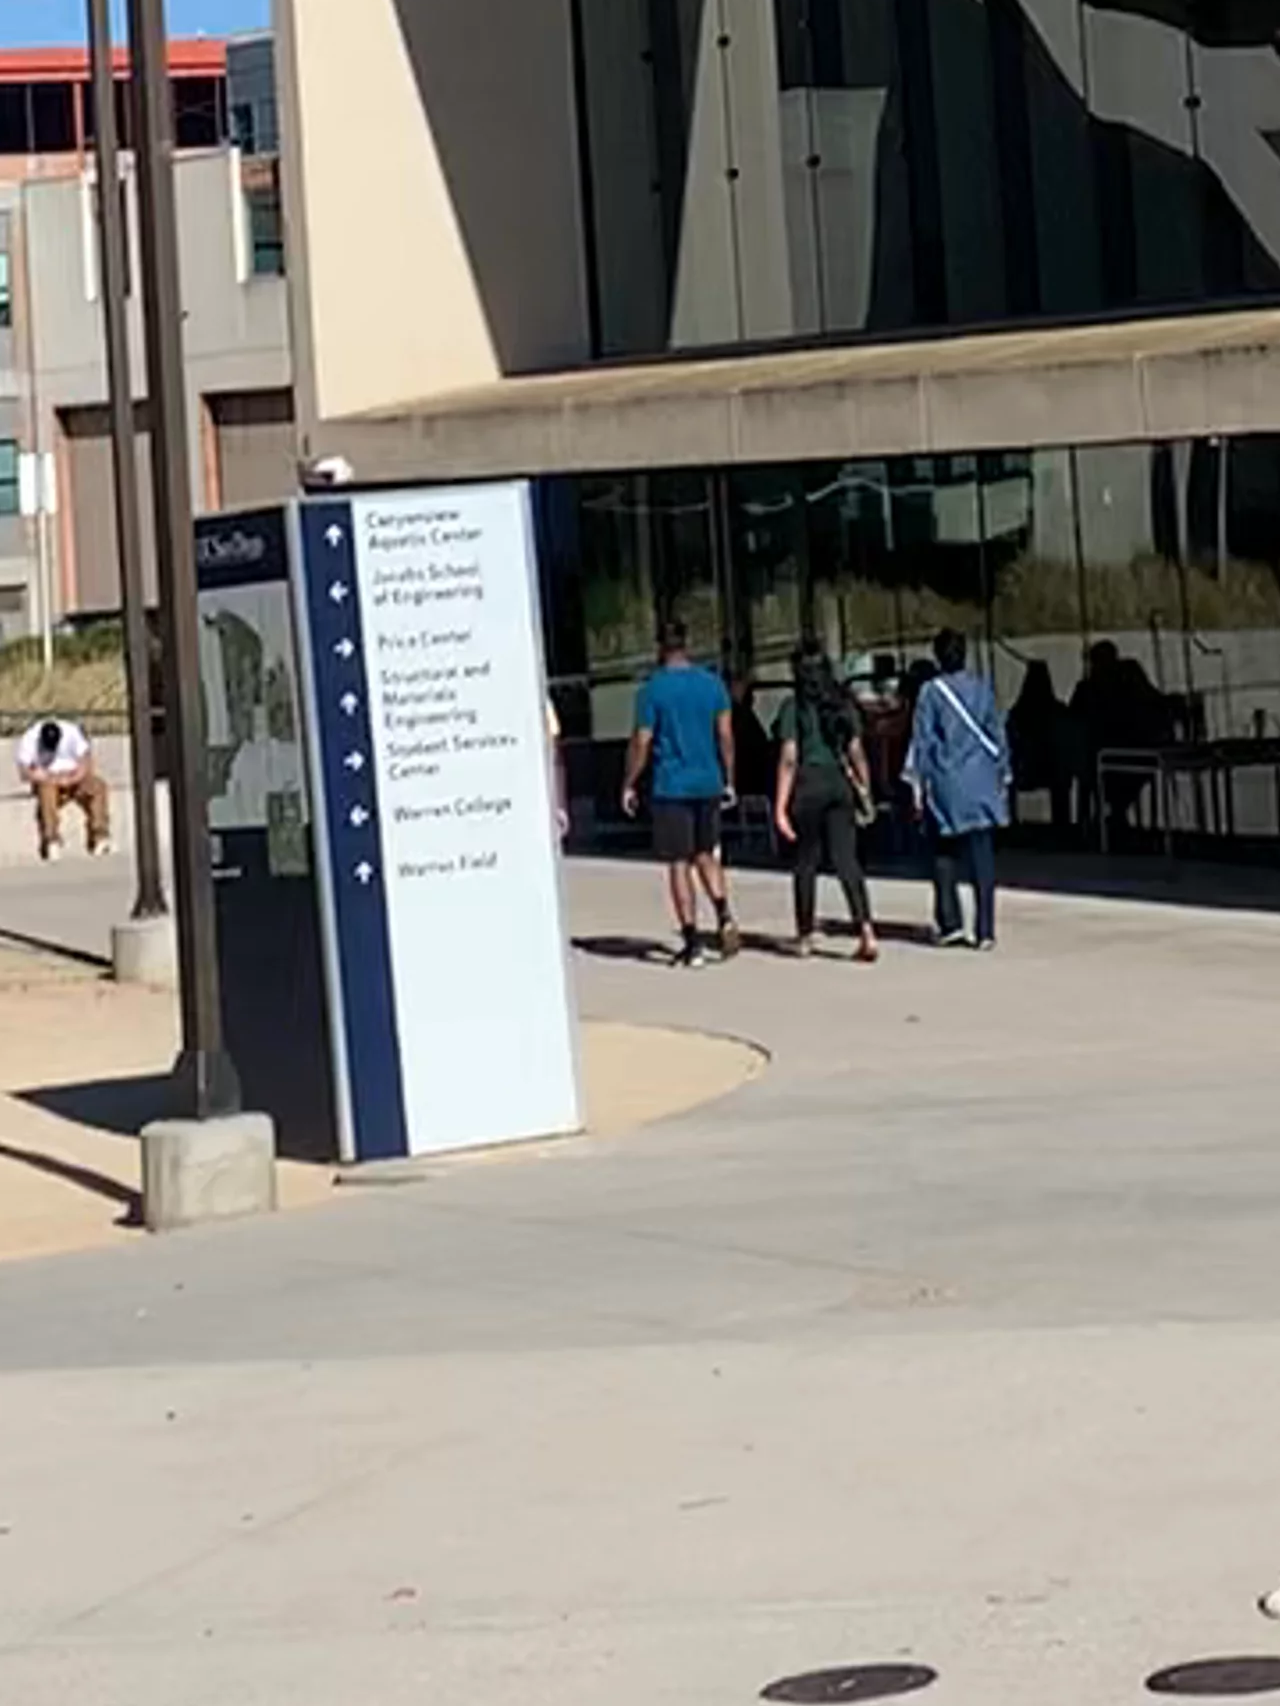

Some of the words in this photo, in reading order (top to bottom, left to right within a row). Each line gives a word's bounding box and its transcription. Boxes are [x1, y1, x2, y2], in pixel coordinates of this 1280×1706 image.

[368, 535, 426, 553] Aquatic
[430, 527, 483, 545] Center
[373, 566, 425, 585] Jacobs
[428, 561, 479, 581] School
[373, 589, 387, 606] of
[392, 586, 483, 606] Engineering
[378, 633, 417, 650] Price
[421, 630, 472, 647] Center
[381, 667, 457, 684] Structural
[464, 660, 490, 678] and
[382, 689, 456, 706] Materials
[384, 709, 476, 731] Engineering
[386, 738, 448, 756] Student
[452, 735, 518, 751] Services
[388, 763, 440, 780] Center
[394, 804, 450, 823] Warren
[454, 796, 512, 816] College
[398, 861, 454, 879] Warren
[460, 851, 497, 870] Field
